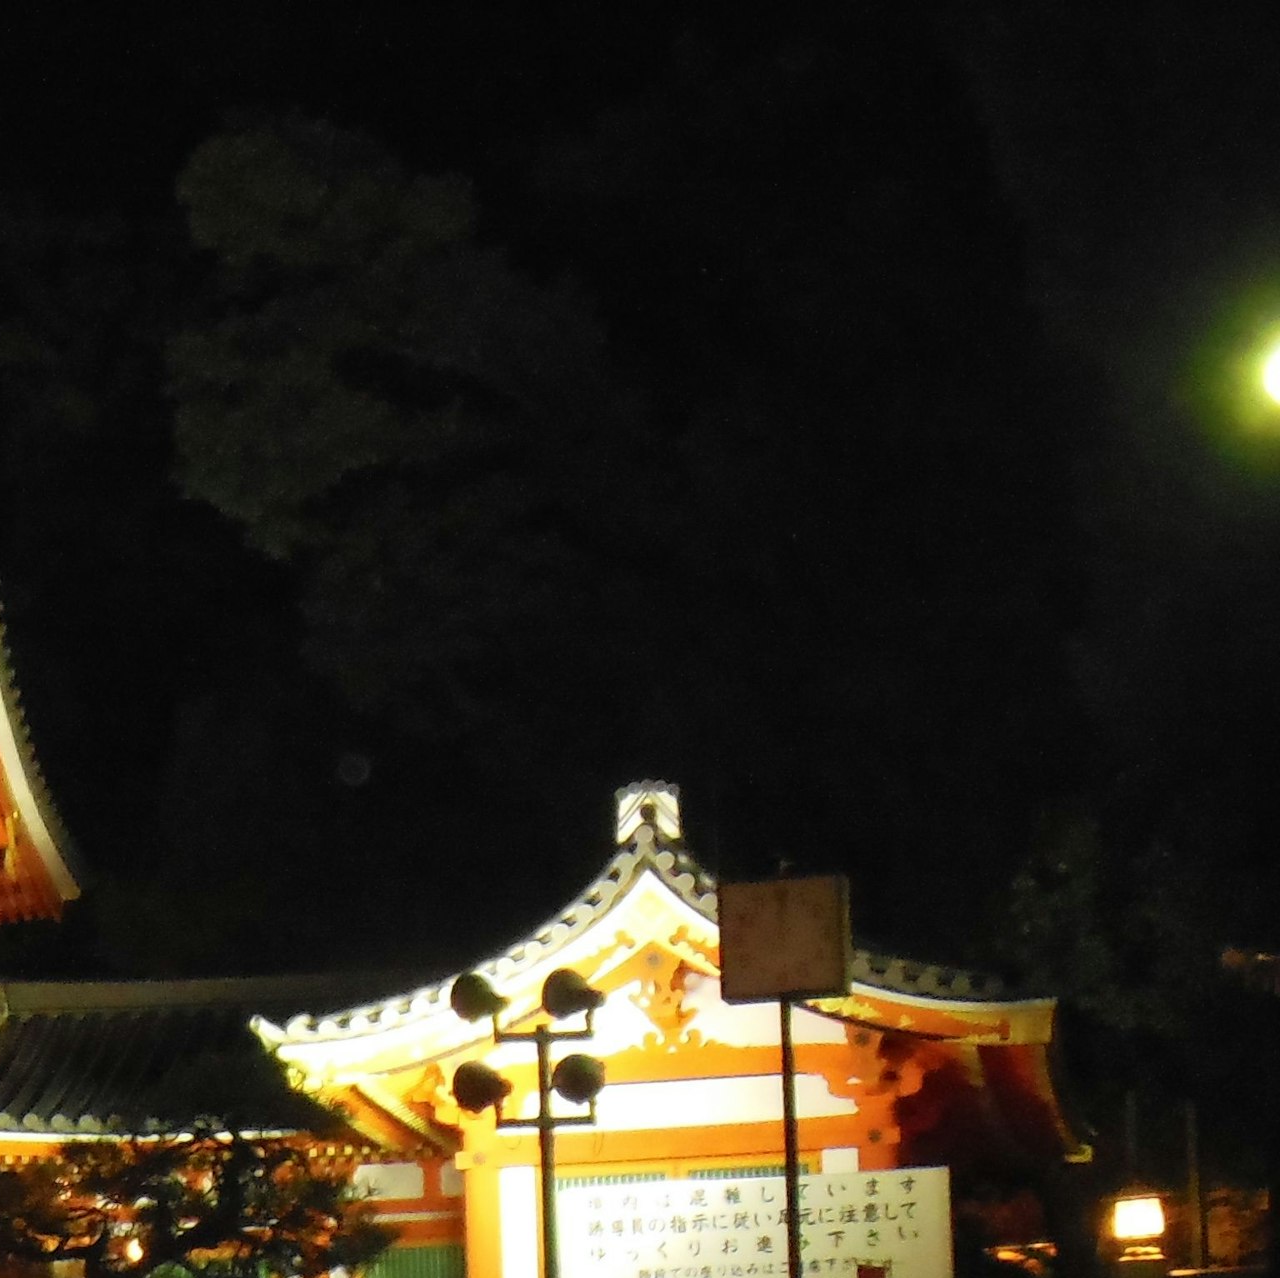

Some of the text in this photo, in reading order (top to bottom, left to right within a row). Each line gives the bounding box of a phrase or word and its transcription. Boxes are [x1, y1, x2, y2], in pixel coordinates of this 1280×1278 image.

[589, 1226, 920, 1262] ゆっくりお進み下さい
